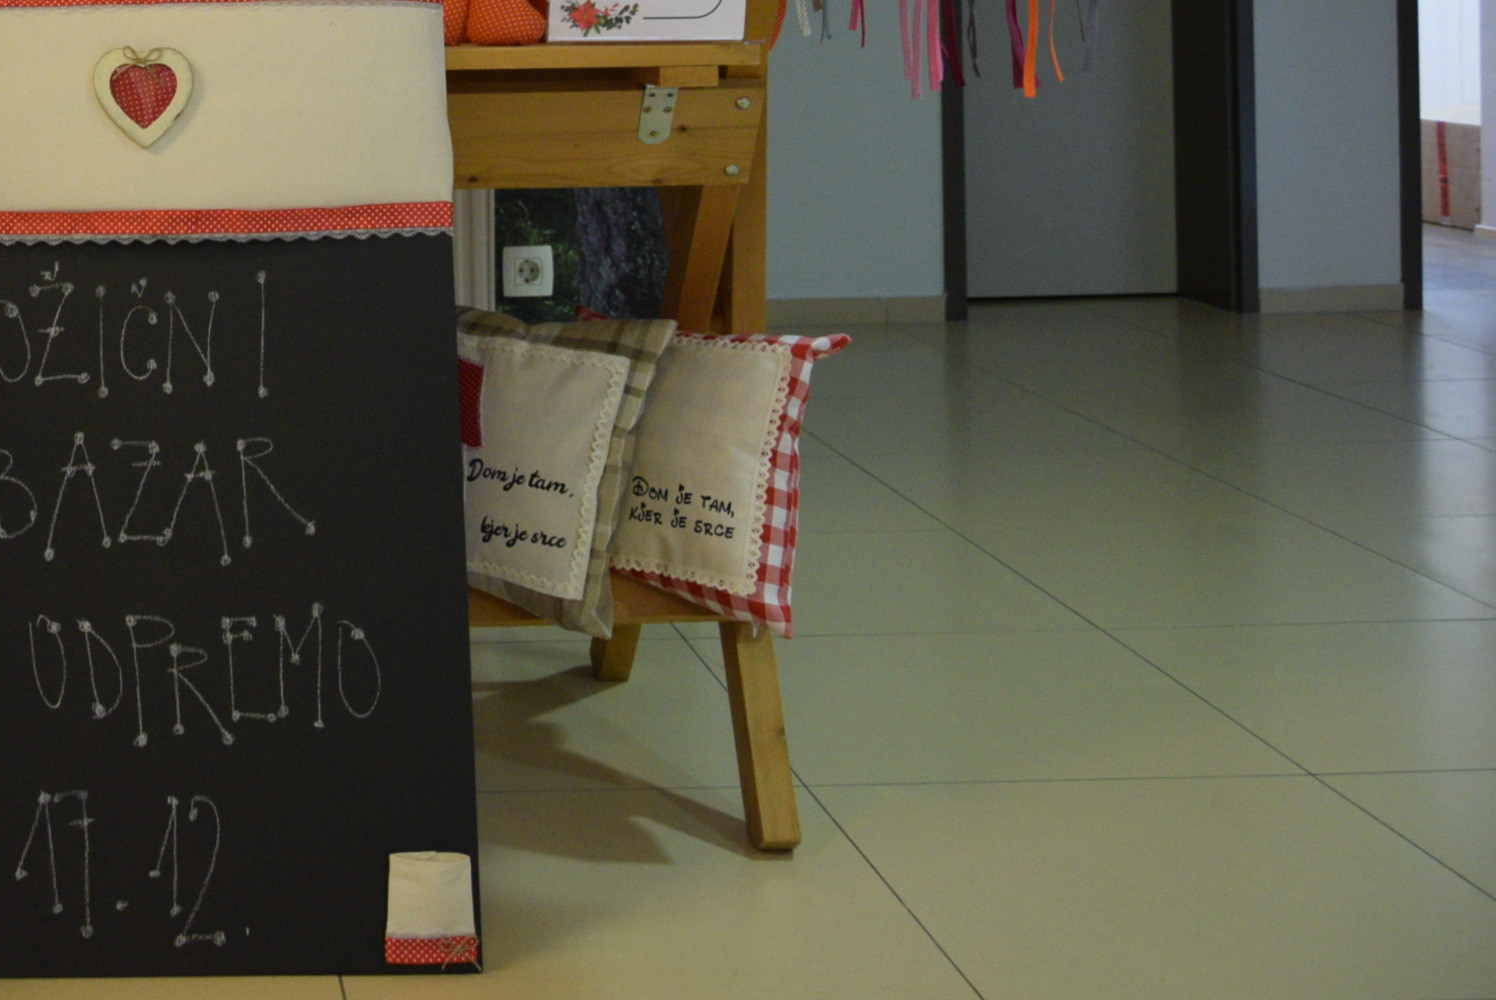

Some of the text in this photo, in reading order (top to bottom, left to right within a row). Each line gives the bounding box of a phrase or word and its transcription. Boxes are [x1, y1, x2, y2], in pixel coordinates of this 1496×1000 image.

[467, 458, 508, 482] Dom
[503, 466, 525, 491] je
[481, 516, 567, 548] kjer je srce
[28, 602, 382, 747] ODPREMO
